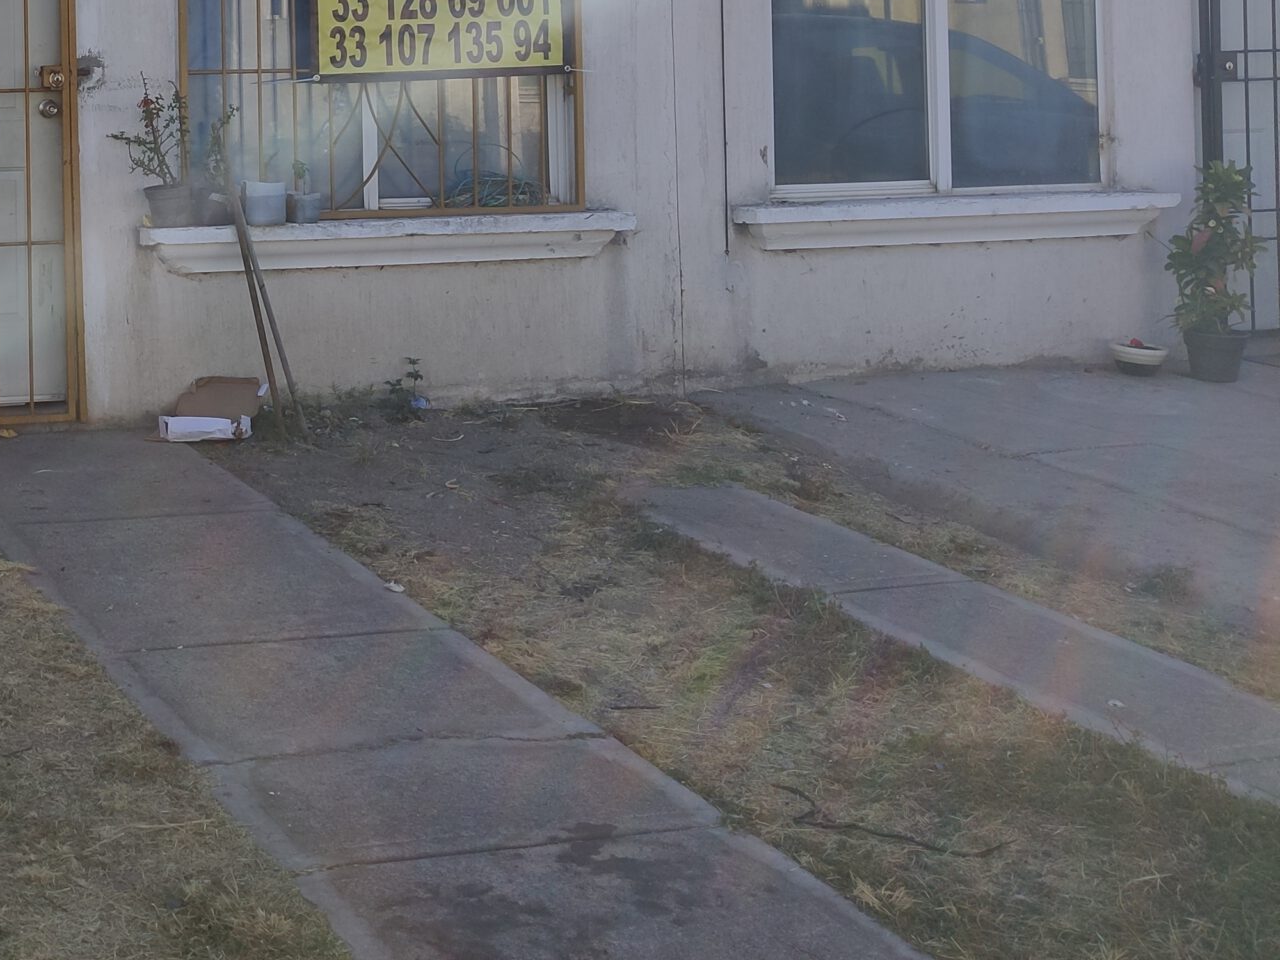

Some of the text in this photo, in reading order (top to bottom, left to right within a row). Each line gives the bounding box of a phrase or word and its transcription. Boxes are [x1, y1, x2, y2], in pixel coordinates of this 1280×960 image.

[329, 19, 551, 68] 33 107 135 94
